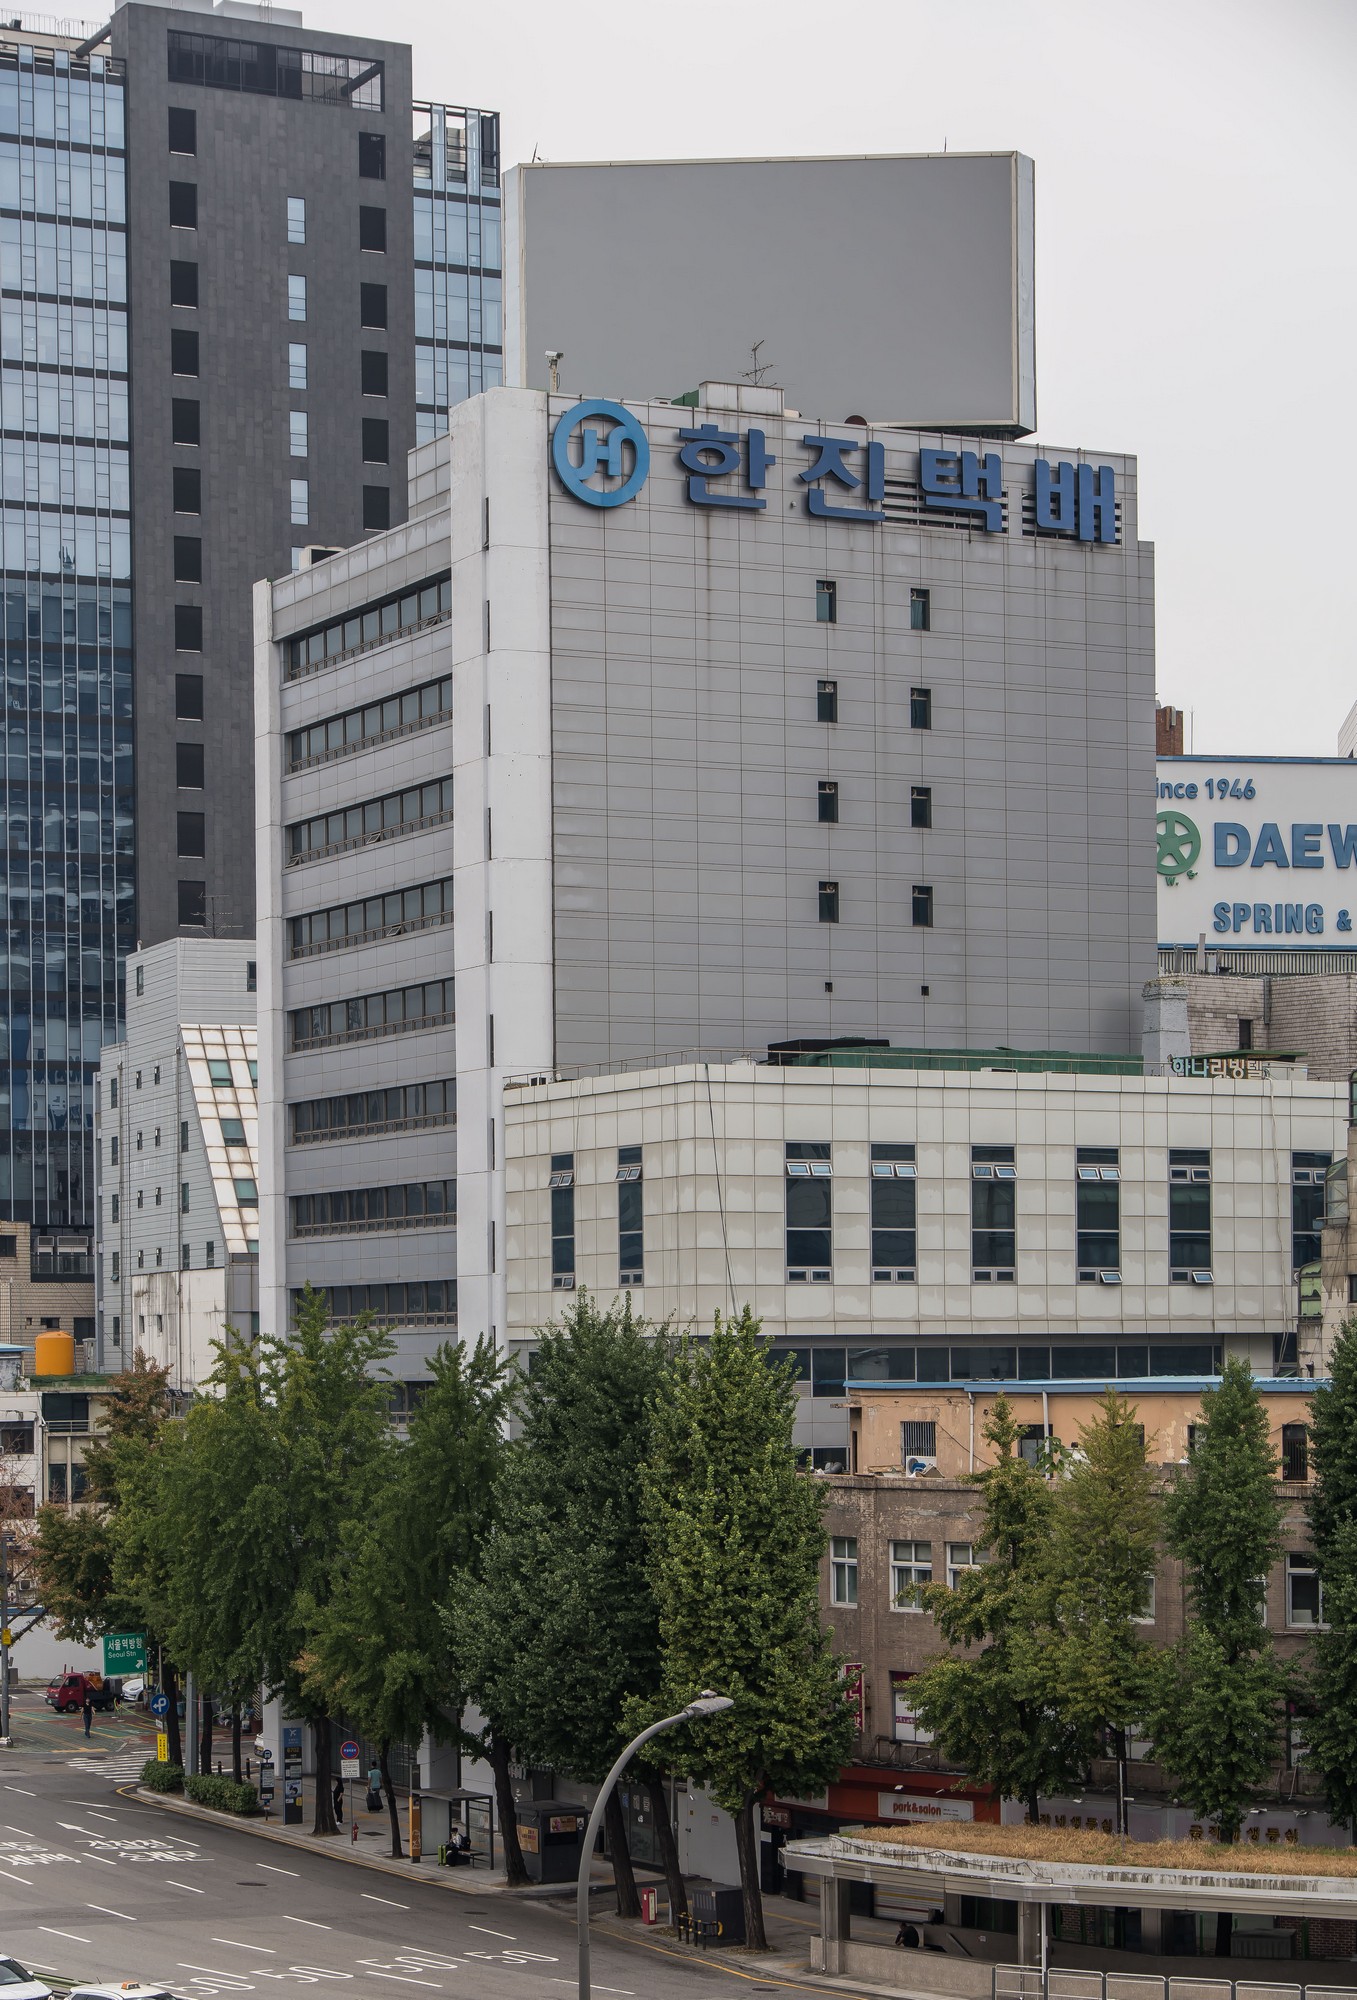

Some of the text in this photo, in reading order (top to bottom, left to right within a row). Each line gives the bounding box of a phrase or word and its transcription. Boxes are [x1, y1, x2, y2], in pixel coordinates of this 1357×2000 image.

[678, 423, 1116, 544] 한진택배
[1204, 777, 1256, 800] 1946
[1213, 822, 1357, 868] DAEW
[1213, 901, 1353, 934] SPRING &
[1172, 1058, 1263, 1079] 하나리빙텔
[107, 1637, 143, 1651] 서울역방향
[108, 1650, 137, 1659] Seoul Stn
[892, 1801, 942, 1816] park&salon
[355, 1956, 458, 1973] 50
[463, 1950, 559, 1965] 50
[250, 1966, 354, 1983] 50
[150, 1977, 256, 1995] 50
